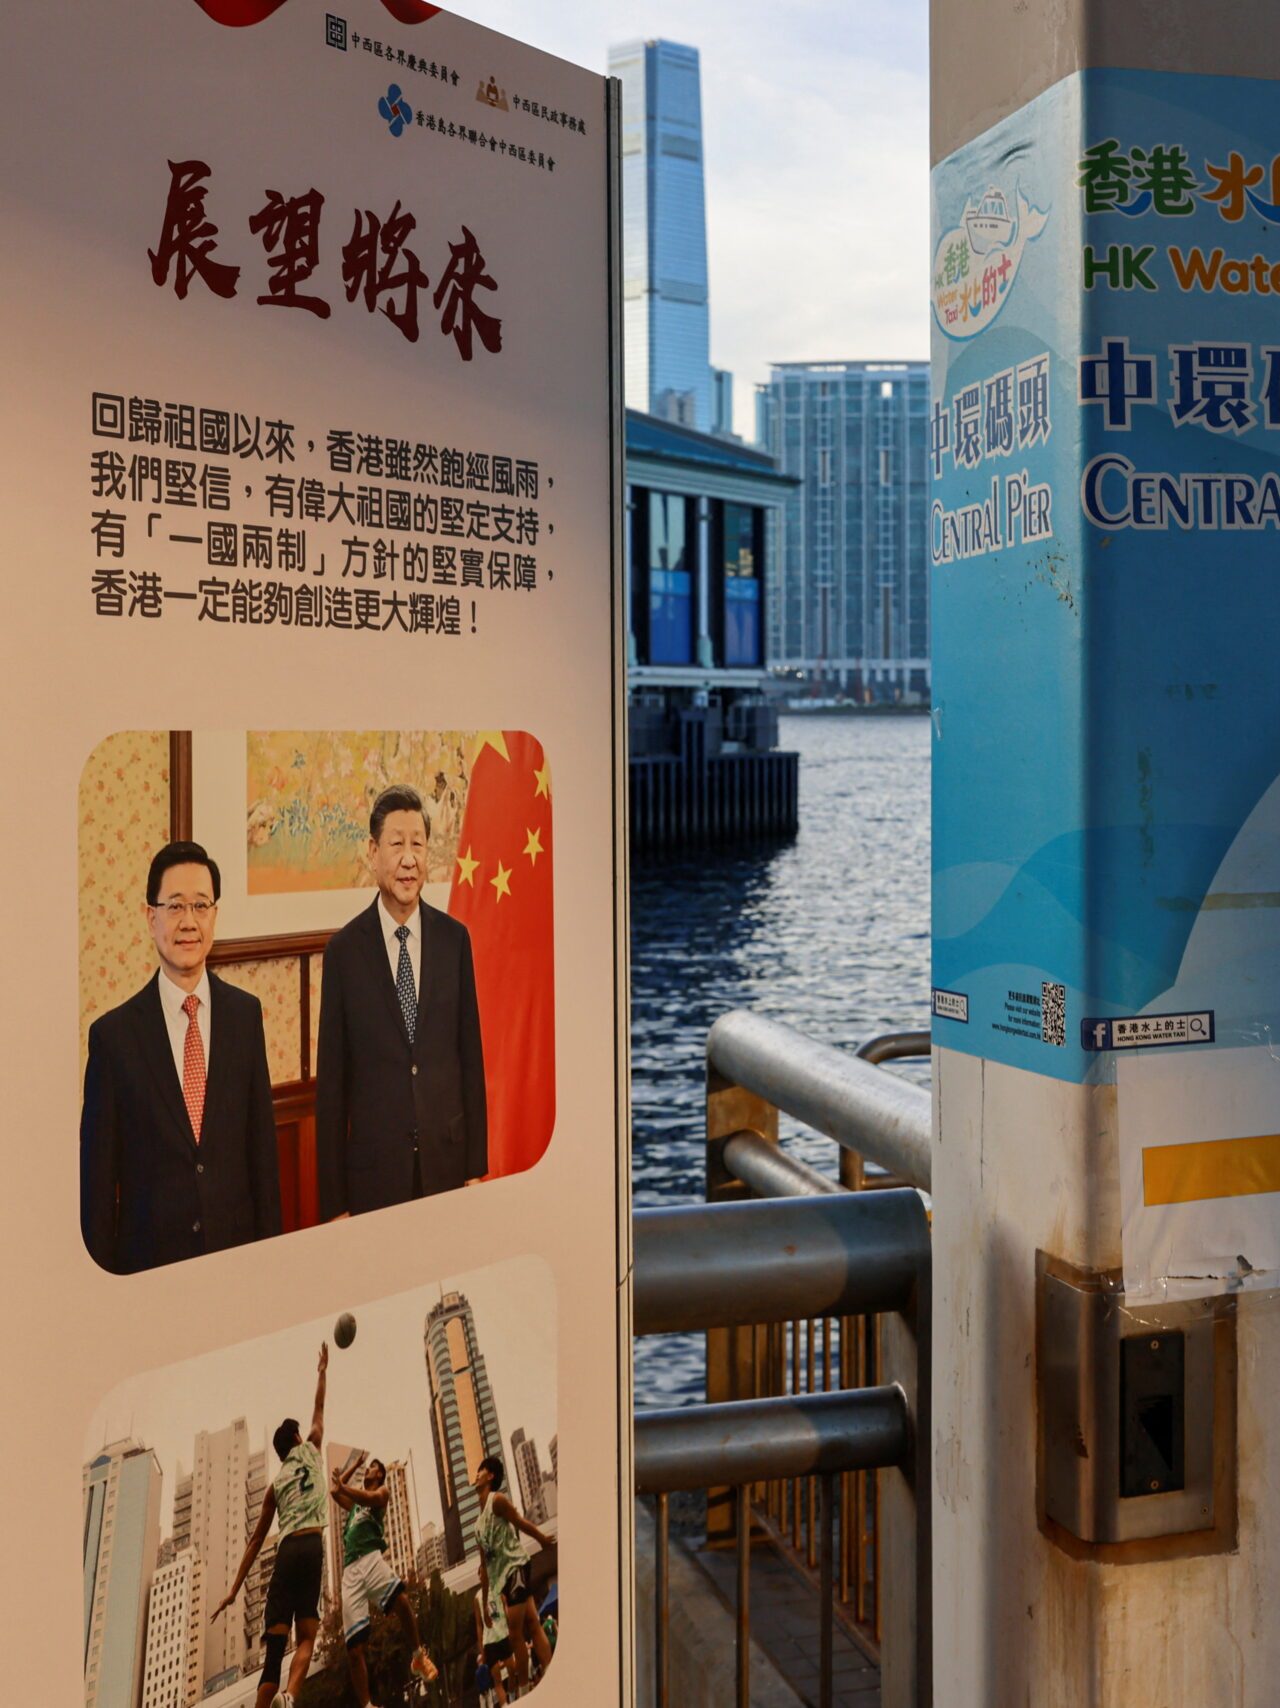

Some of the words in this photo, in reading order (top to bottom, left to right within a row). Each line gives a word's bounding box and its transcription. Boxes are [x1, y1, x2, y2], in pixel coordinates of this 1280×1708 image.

[351, 32, 460, 87] 中西區各界慶典委員會
[416, 110, 556, 172] 香港島各界聯合會中西區委員會
[147, 159, 502, 361] 展望將來
[1082, 244, 1157, 290] HK
[931, 353, 1051, 479] 中環碼頭
[1118, 1020, 1185, 1034] 香港水上的士
[293, 1466, 314, 1492] 2
